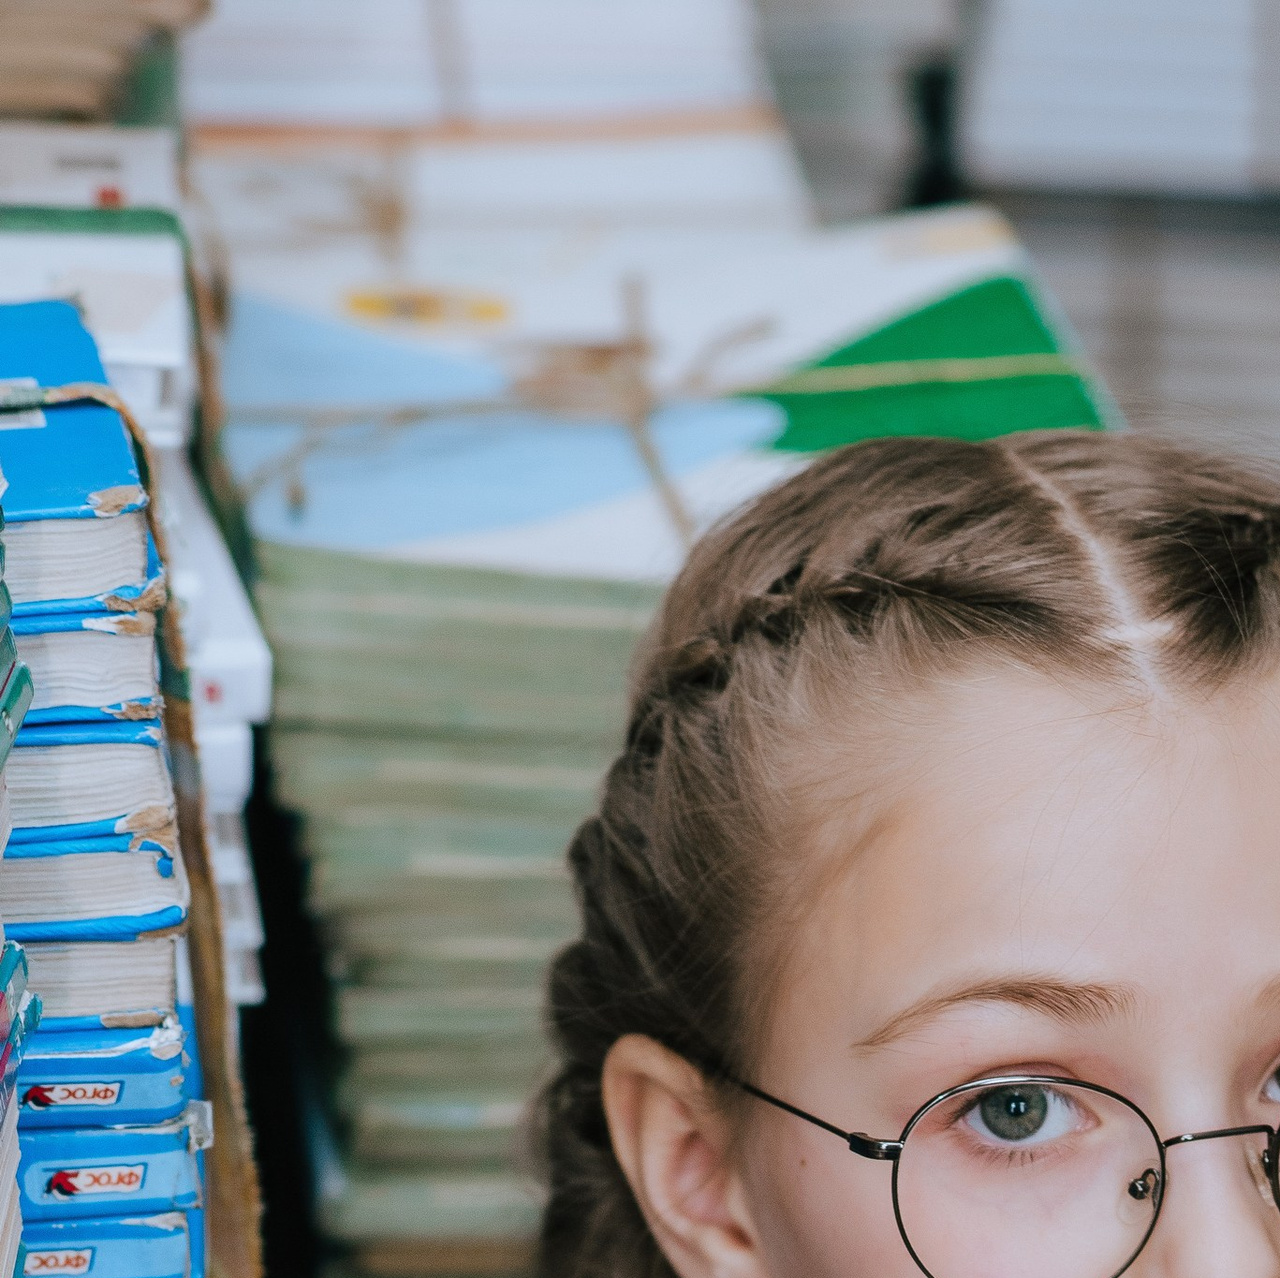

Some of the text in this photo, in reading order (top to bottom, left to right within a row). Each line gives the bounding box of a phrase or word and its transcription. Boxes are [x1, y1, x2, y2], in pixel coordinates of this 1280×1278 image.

[59, 1087, 115, 1101] ФГОС
[84, 1171, 141, 1188] ФГОС
[32, 1255, 87, 1270] ФГОС
